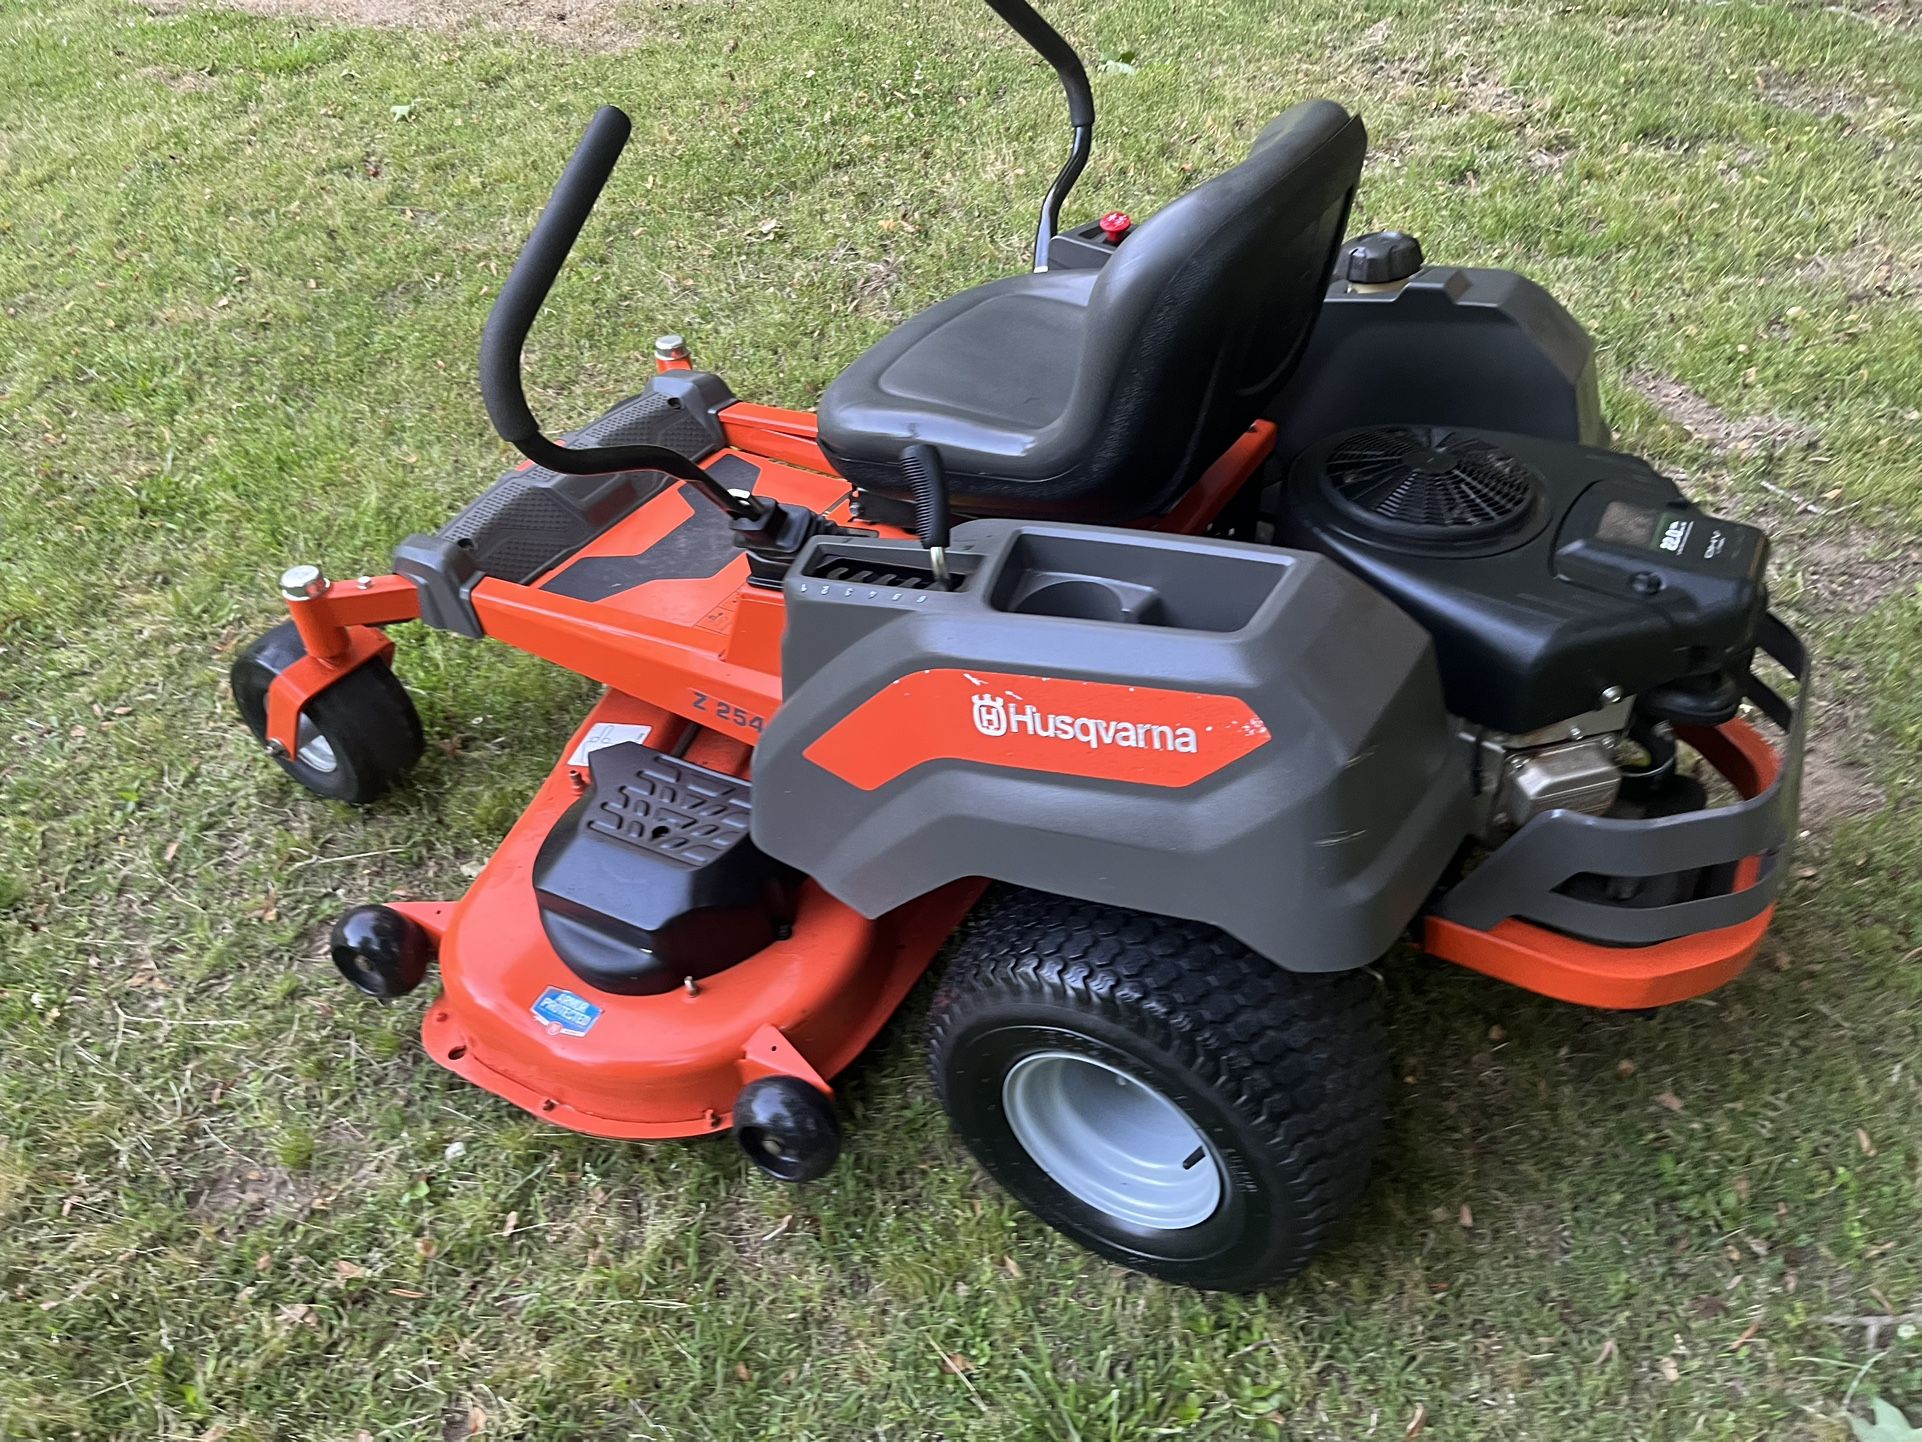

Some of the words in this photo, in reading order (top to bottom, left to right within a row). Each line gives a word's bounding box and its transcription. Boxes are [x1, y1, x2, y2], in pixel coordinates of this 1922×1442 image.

[821, 585, 830, 595] 2
[844, 587, 853, 596] 3
[692, 691, 708, 712] Z
[716, 701, 764, 733] 254
[1008, 703, 1198, 753] Husqvarna
